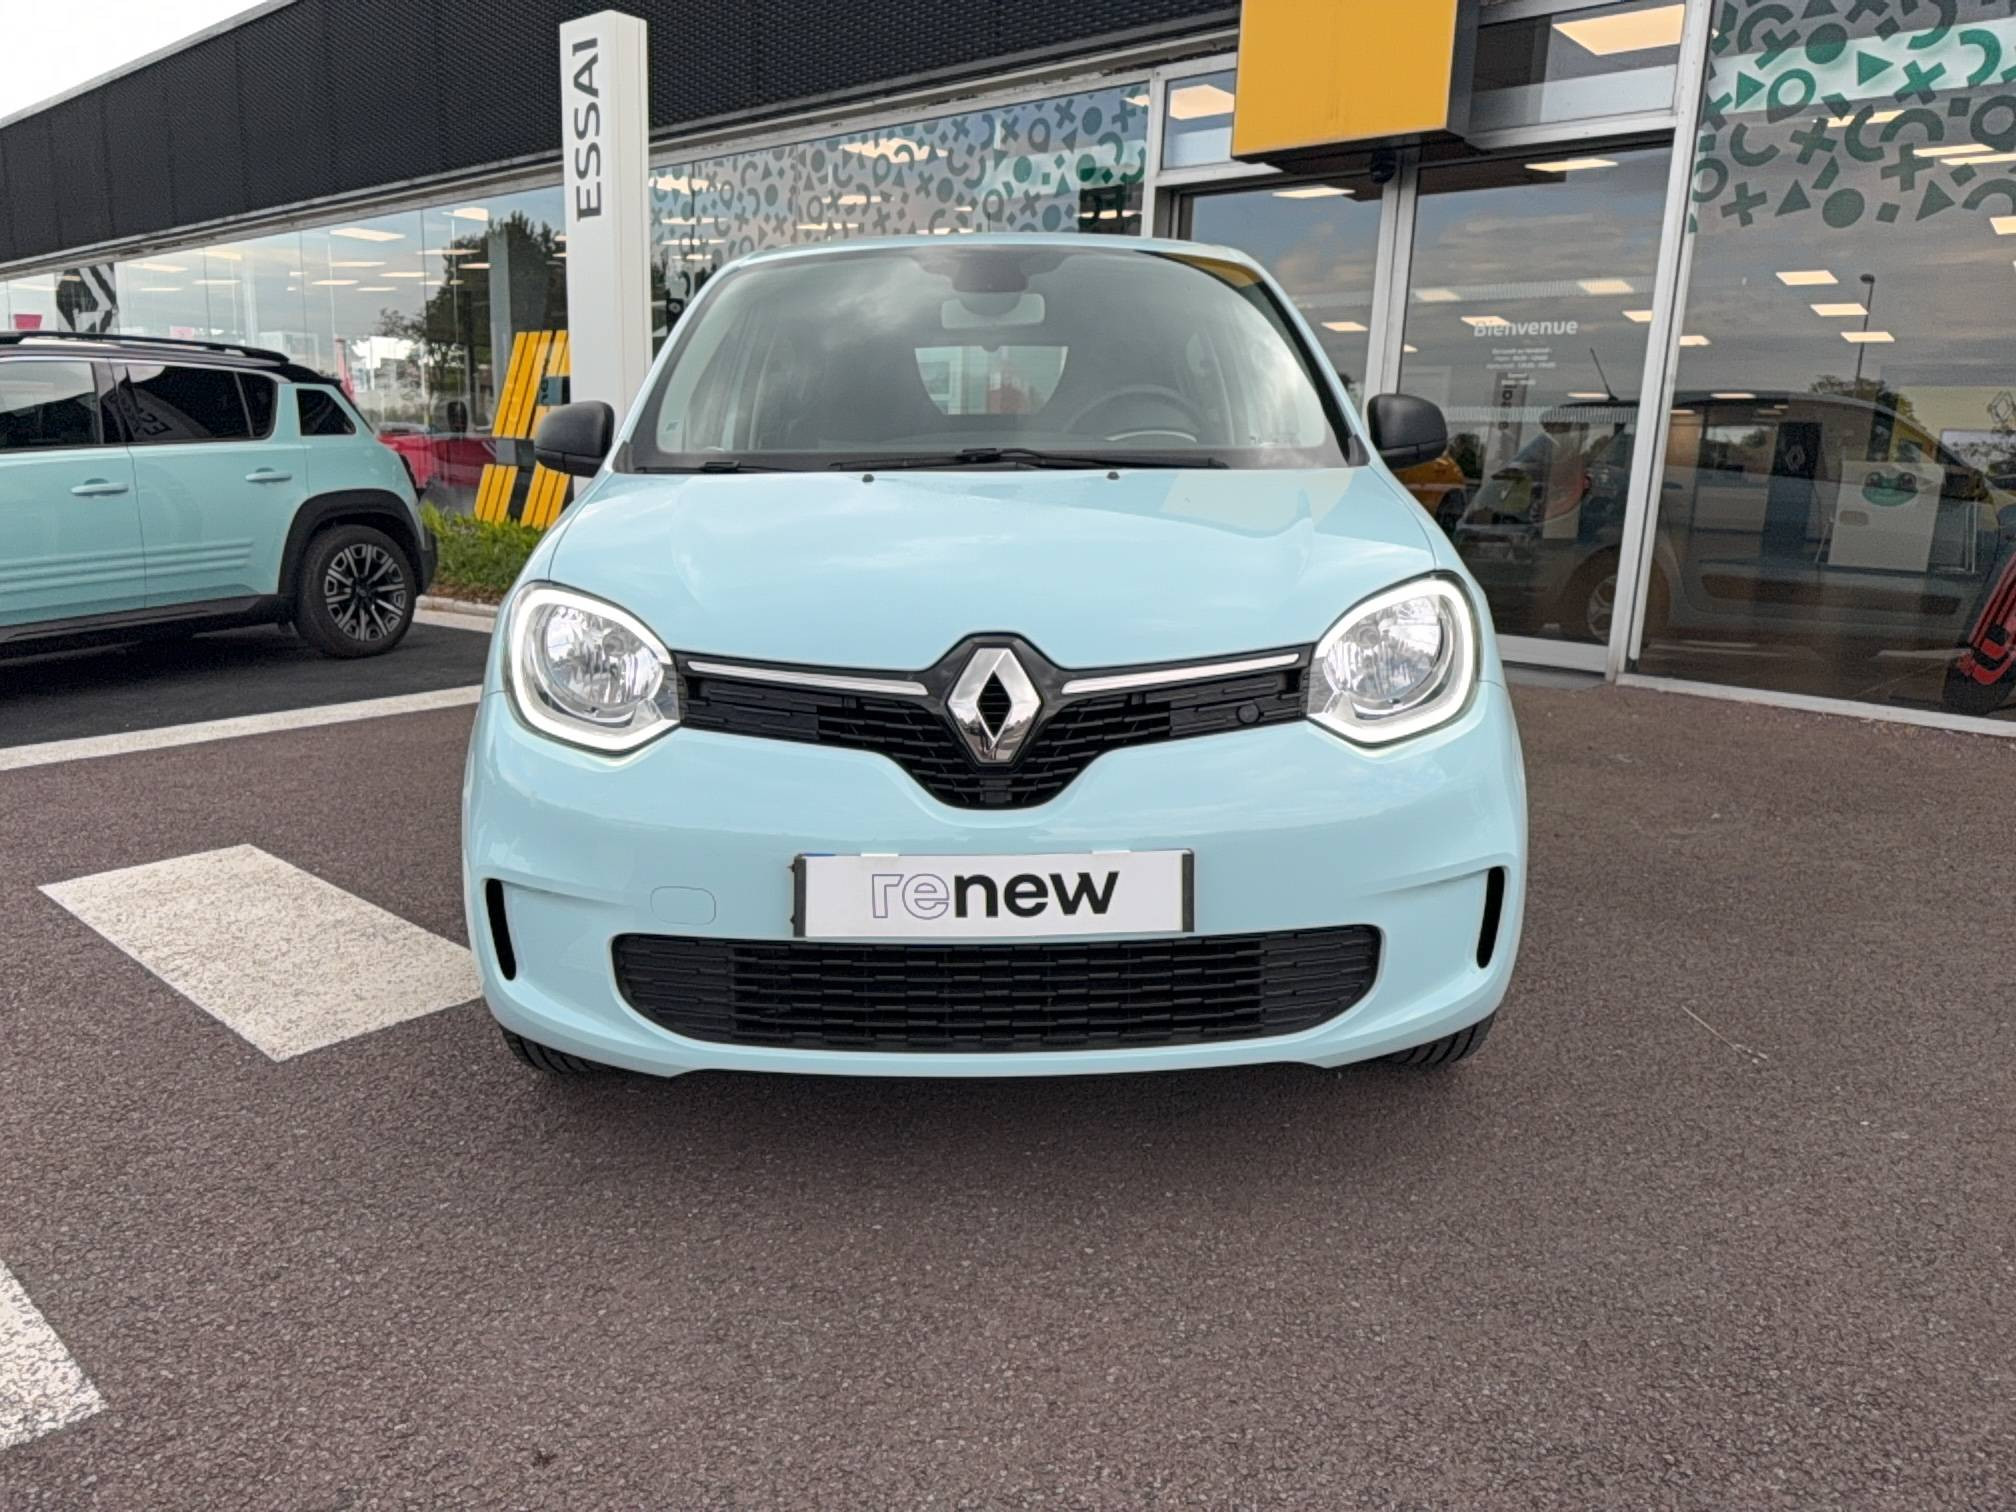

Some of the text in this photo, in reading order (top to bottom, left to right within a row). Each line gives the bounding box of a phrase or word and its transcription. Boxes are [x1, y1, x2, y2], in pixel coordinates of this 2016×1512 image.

[572, 37, 602, 221] ESSAI
[1474, 320, 1579, 337] Bienvenue
[871, 871, 1120, 920] renew
